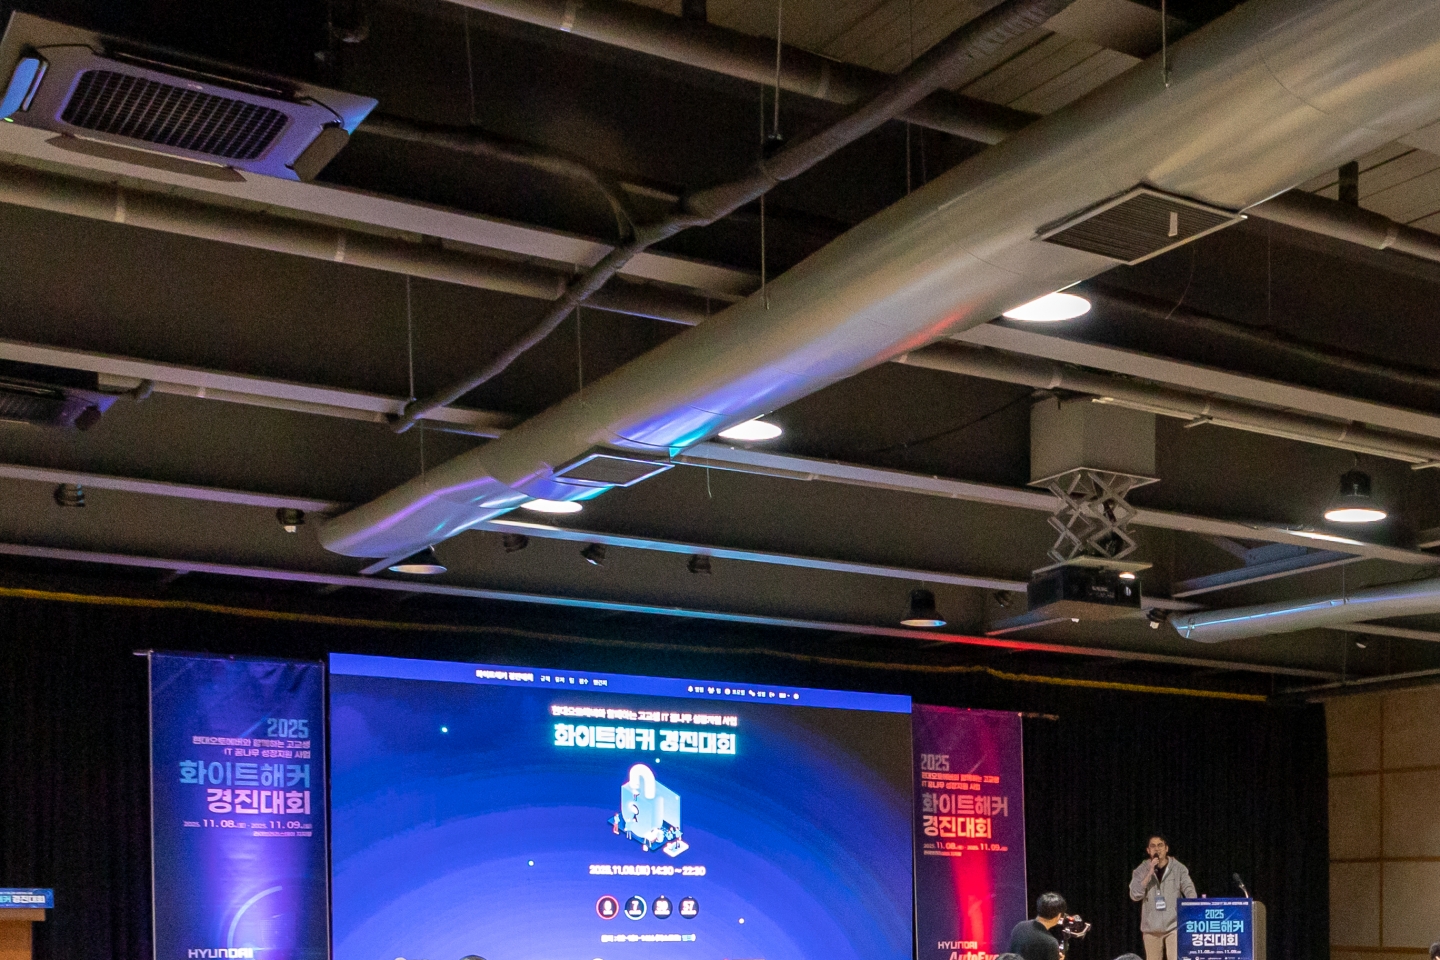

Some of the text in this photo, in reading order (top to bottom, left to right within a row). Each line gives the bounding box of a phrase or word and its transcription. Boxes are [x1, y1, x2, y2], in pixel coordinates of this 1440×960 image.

[267, 717, 309, 738] 2025
[286, 740, 310, 749] 고교생
[554, 723, 736, 754] 화이트해커 경진대회
[224, 748, 310, 759] IT 꿈나무 성장지원 사업
[921, 753, 949, 771] 2025
[179, 760, 310, 788] 화이트해커
[206, 788, 310, 815] 경진대회
[922, 792, 1009, 817] 화이트해커
[923, 815, 992, 839] 경진대회
[631, 900, 639, 911] 7
[1205, 909, 1224, 919] 2025
[1186, 920, 1244, 933] 화이트해커
[938, 941, 978, 950] HYUNDAI
[1191, 933, 1238, 946] 경진대회
[188, 947, 253, 959] HYUNDAI
